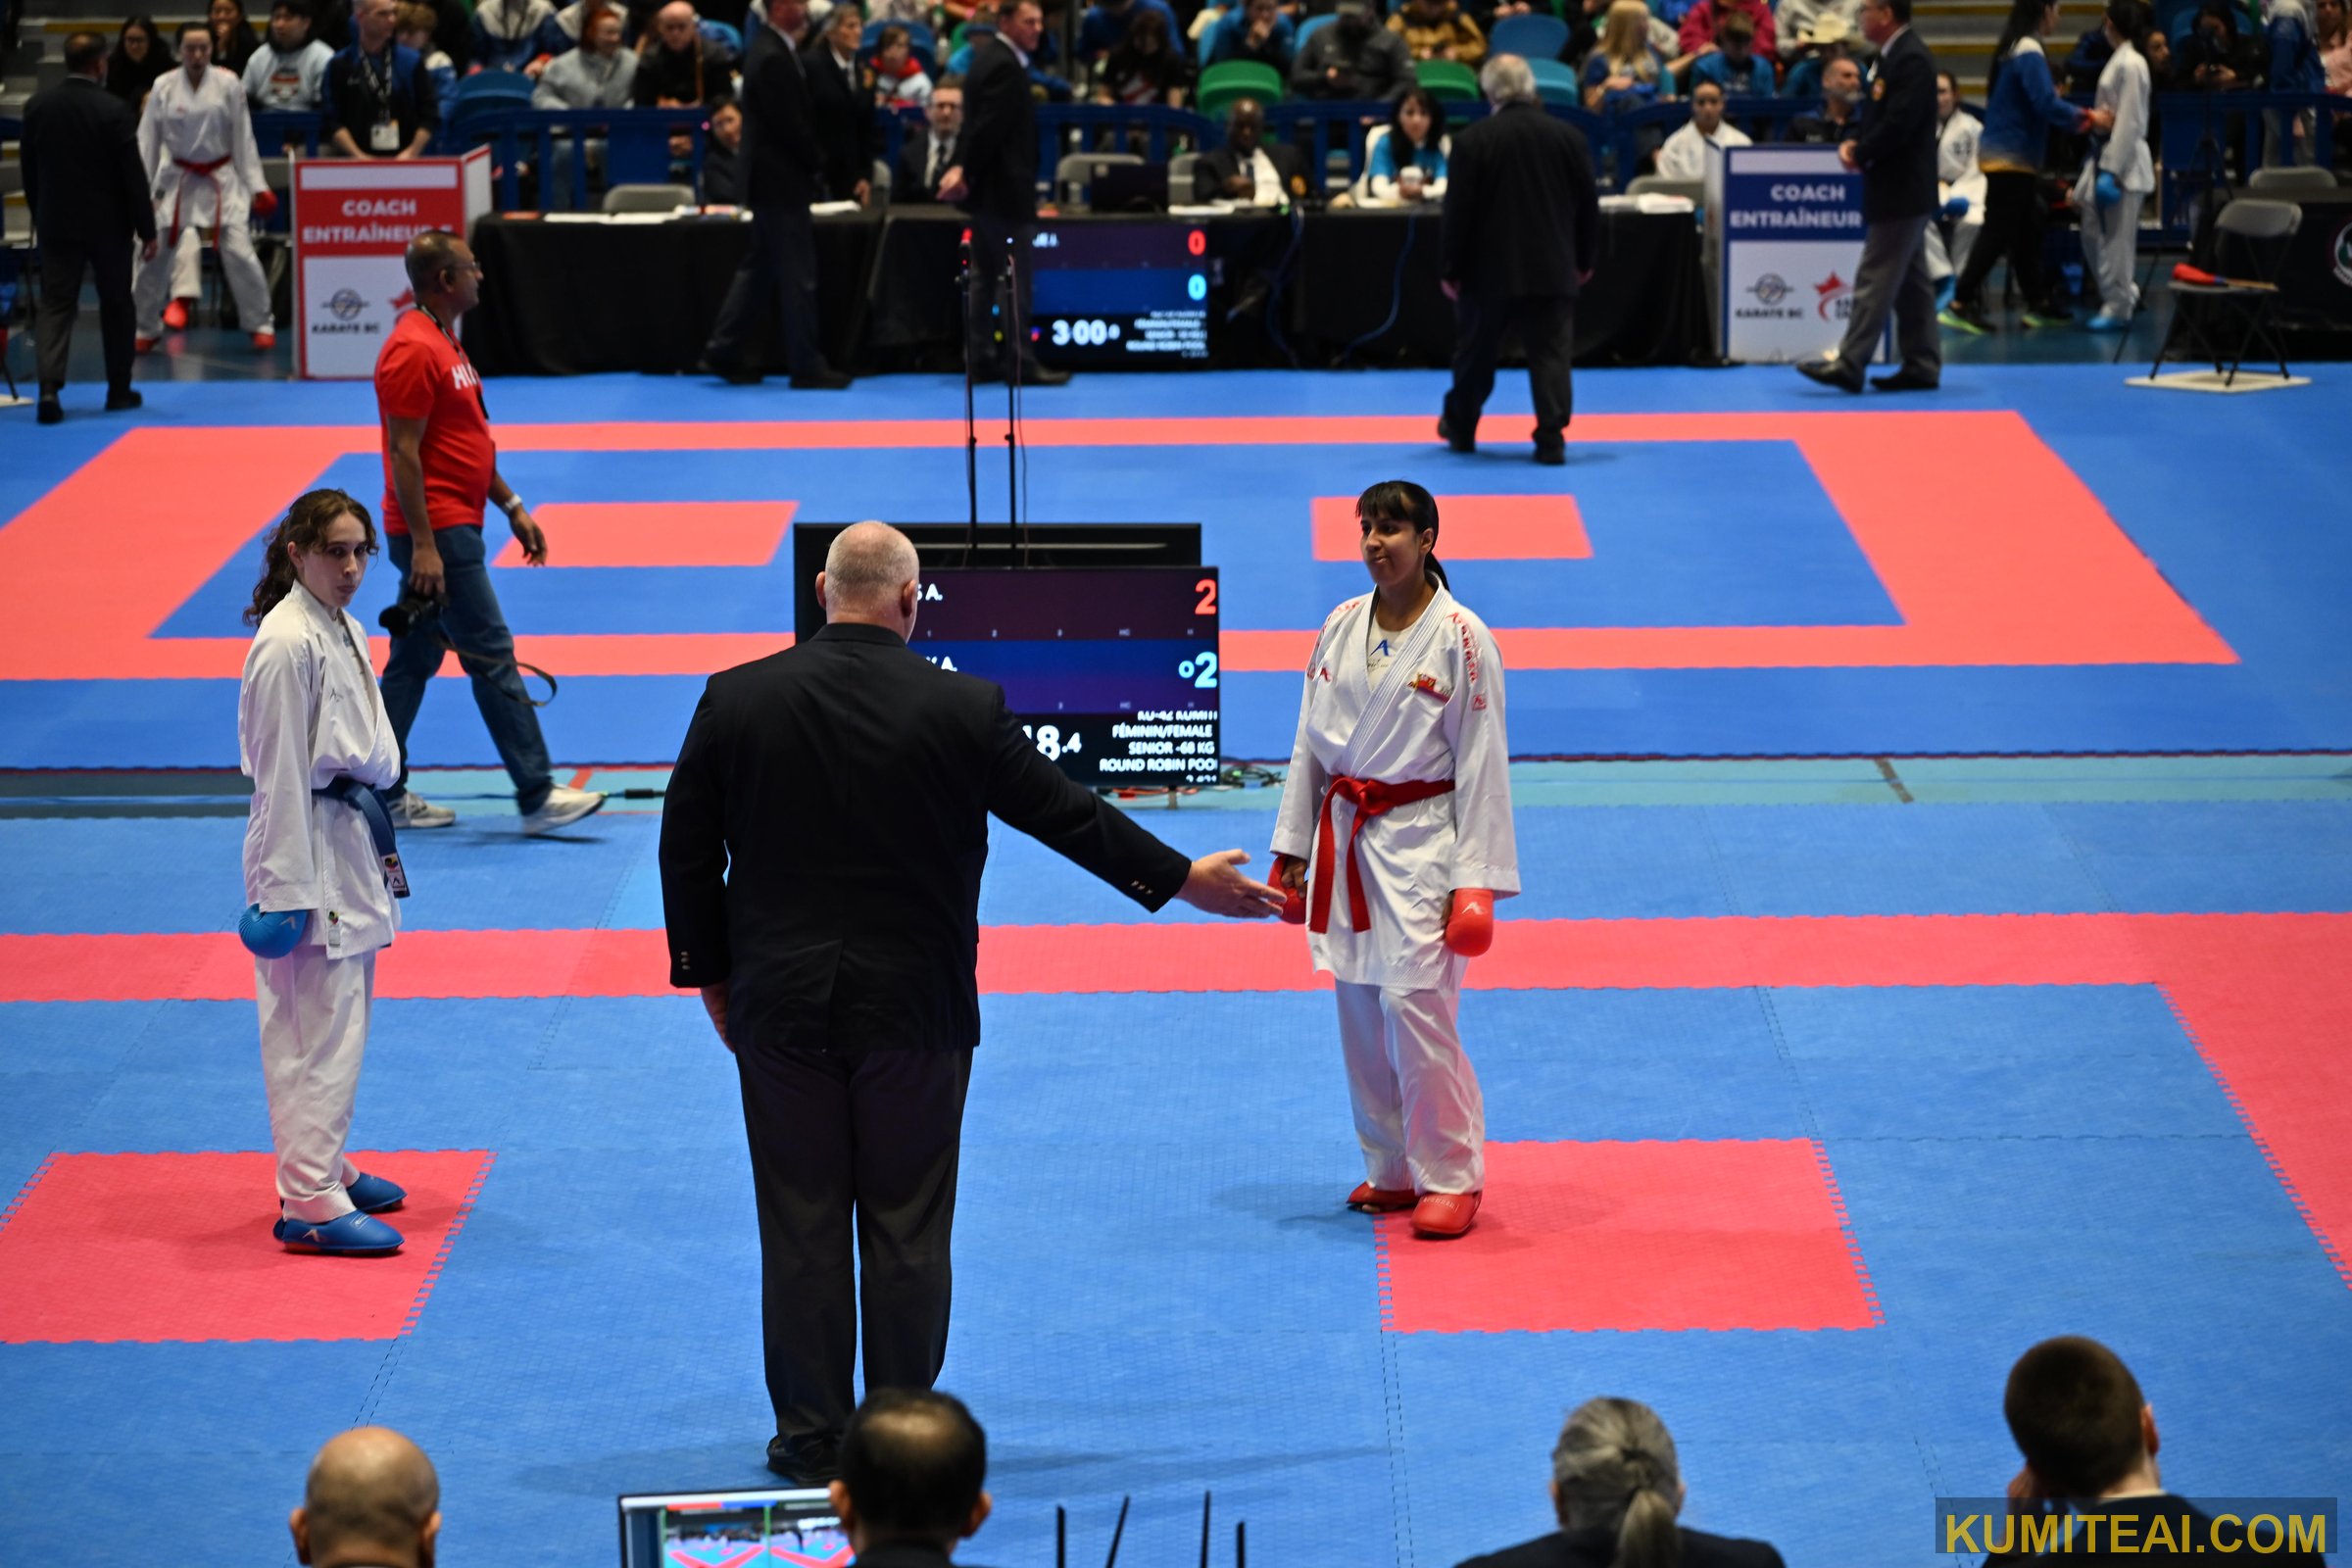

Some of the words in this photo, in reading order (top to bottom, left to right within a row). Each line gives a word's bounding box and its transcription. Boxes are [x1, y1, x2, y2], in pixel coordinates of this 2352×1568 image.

[1771, 183, 1845, 202] COACH
[342, 199, 416, 216] COACH
[1188, 229, 1206, 256] 0
[1188, 273, 1206, 300] 0
[1195, 578, 1217, 614] 2
[1128, 742, 1173, 755] SENIOR
[1198, 742, 1214, 754] KG
[1100, 759, 1146, 772] ROUND
[1147, 759, 1186, 771] ROBIN
